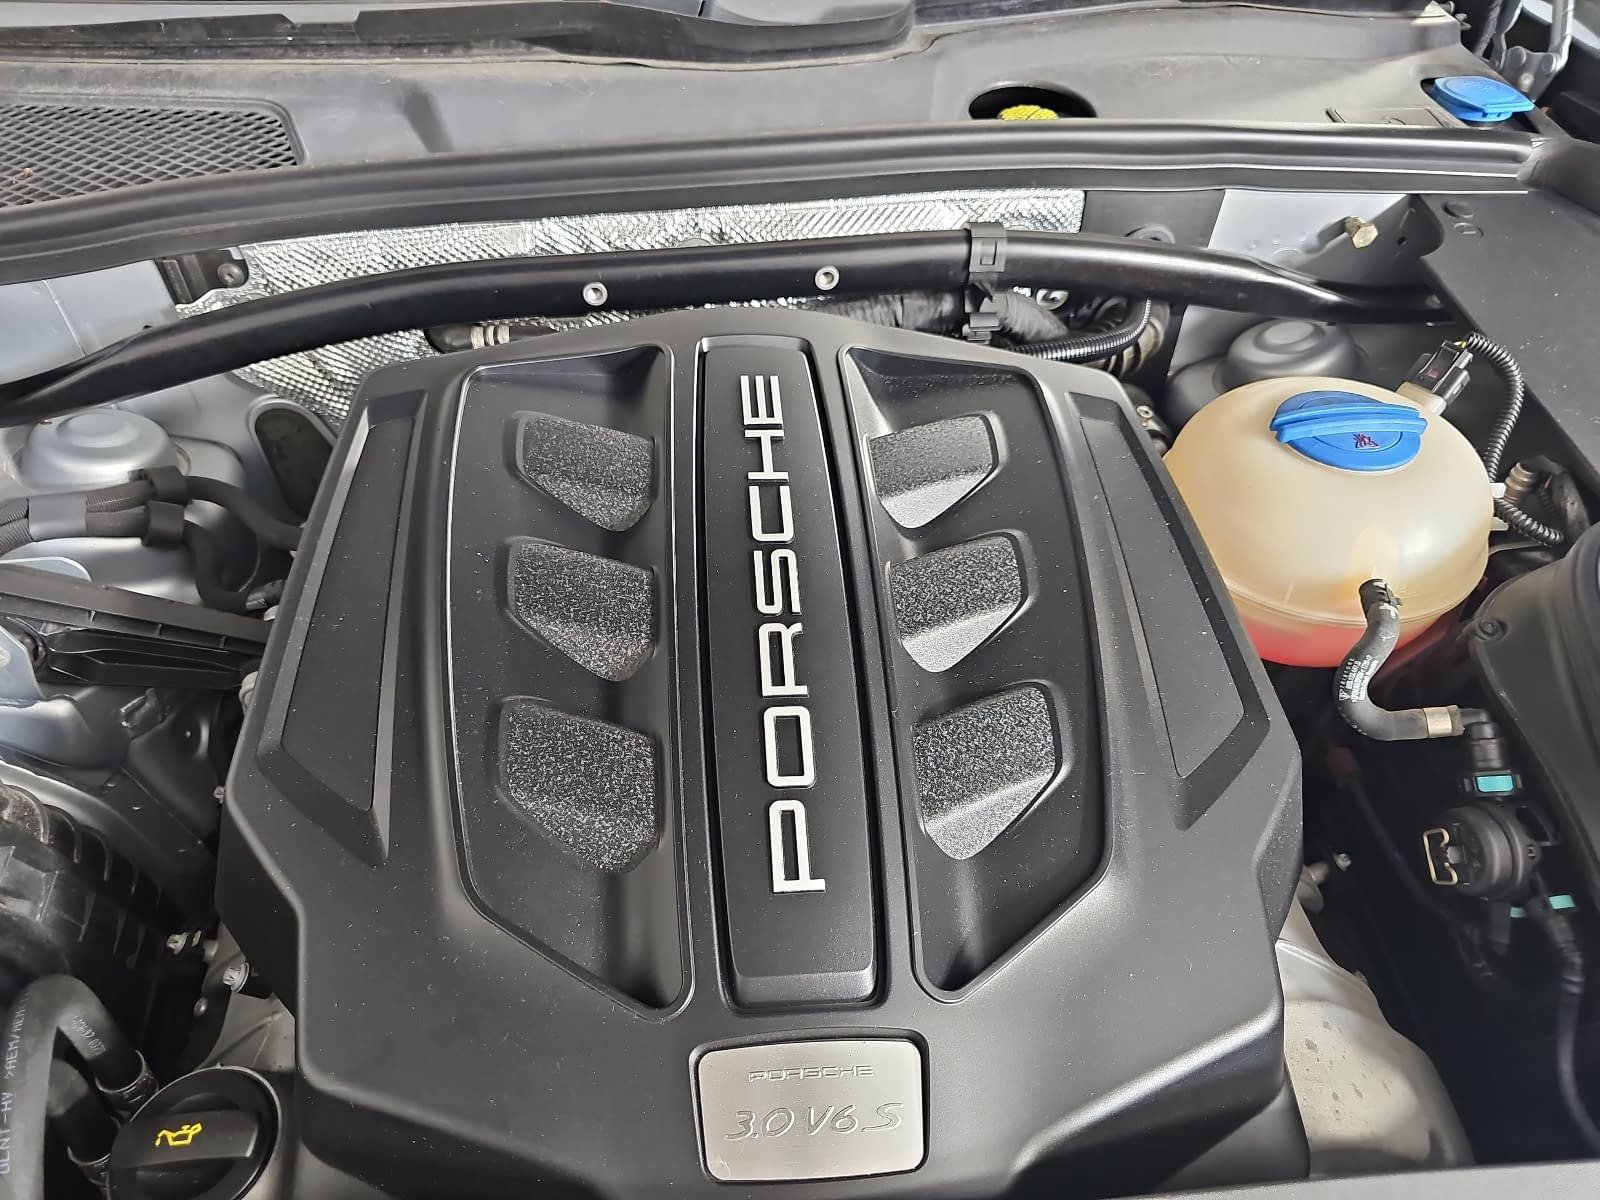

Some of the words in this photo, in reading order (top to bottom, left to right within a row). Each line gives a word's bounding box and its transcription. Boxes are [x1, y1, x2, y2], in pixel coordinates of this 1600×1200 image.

[740, 375, 826, 894] PORSCHE
[750, 1065, 874, 1082] PORSCHE
[724, 1107, 795, 1141] 3.0
[861, 1102, 904, 1132] S
